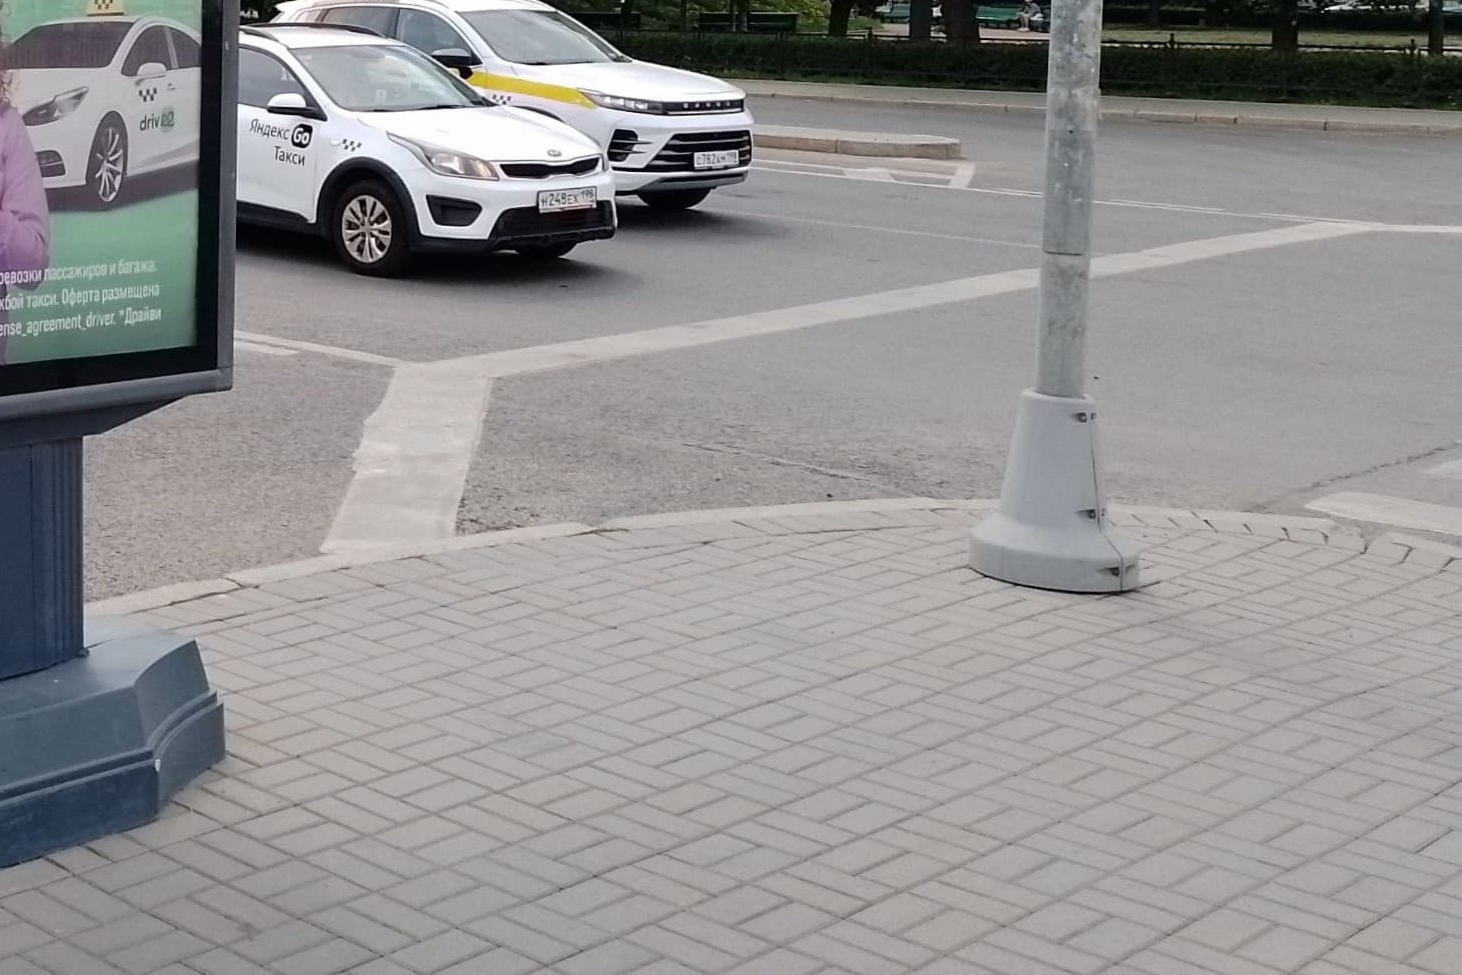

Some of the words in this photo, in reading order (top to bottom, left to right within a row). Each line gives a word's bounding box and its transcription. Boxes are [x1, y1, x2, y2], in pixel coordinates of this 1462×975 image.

[249, 118, 291, 141] Яндекс
[292, 126, 311, 146] Go
[274, 145, 306, 167] Такси
[43, 262, 107, 283] пассажиров
[108, 262, 117, 275] и
[117, 258, 158, 275] багажа.
[26, 293, 60, 309] такси.
[61, 286, 100, 307] Оферта
[101, 283, 160, 303] размещена
